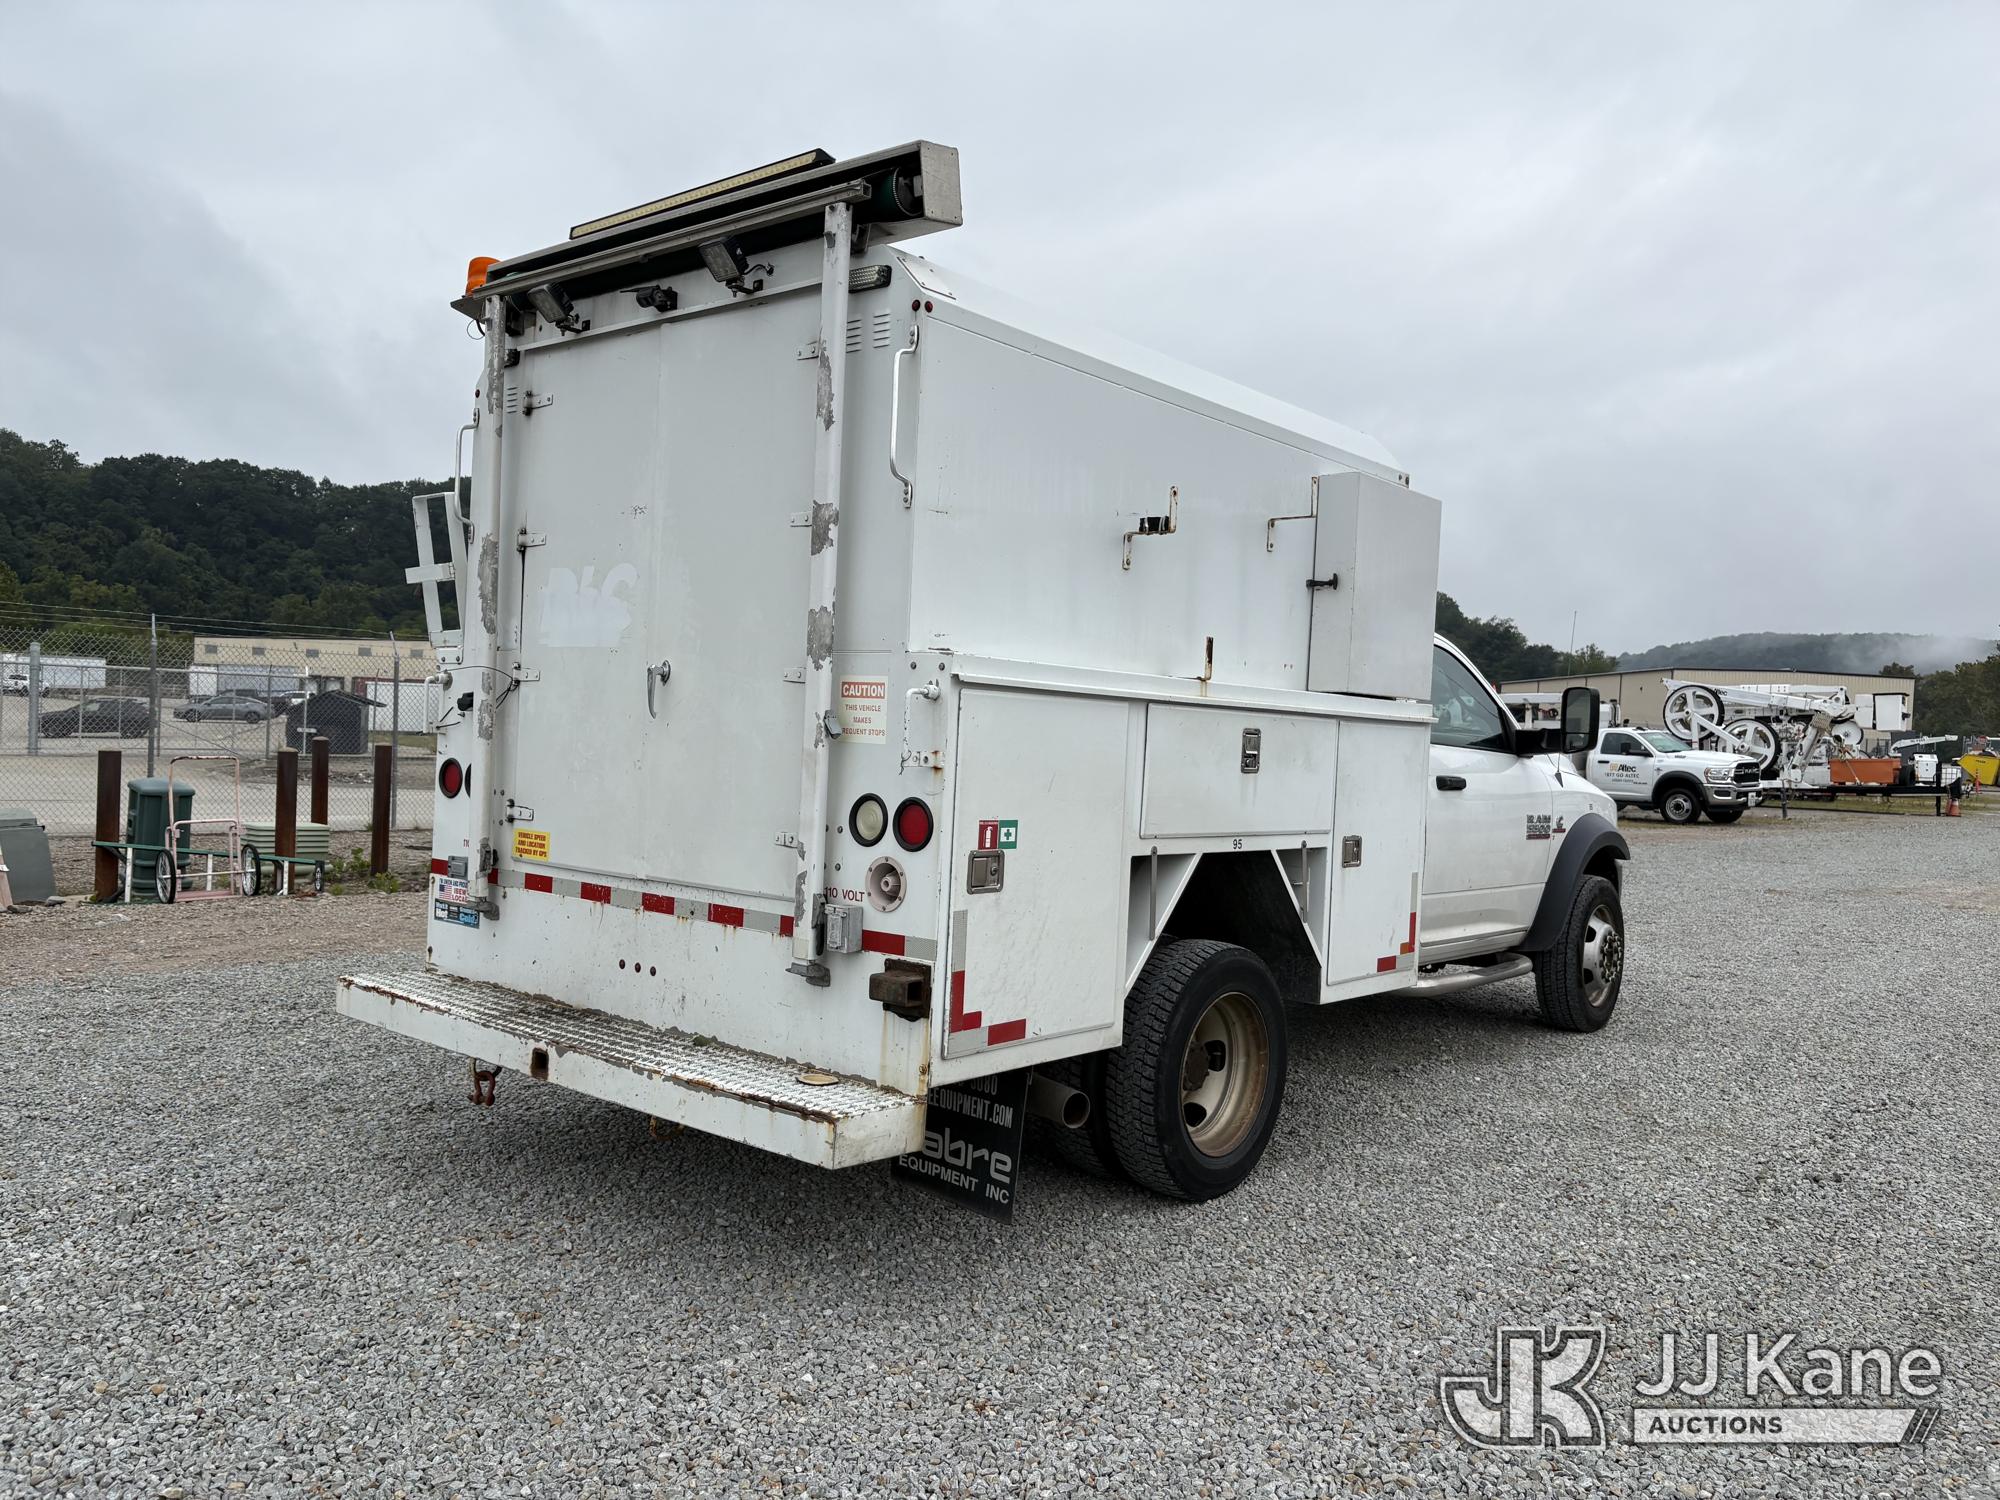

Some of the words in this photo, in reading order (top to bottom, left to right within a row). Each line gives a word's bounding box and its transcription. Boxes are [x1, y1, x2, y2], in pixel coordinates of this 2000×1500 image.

[842, 683, 885, 697] CAUTION
[845, 704, 858, 712] THIS
[858, 704, 882, 713] VEHICLE
[852, 716, 872, 724] MAKES
[841, 727, 867, 736] REQUENT
[868, 728, 886, 737] STOPS
[1617, 763, 1637, 773] Altec
[1526, 814, 1551, 824] RAM
[1232, 838, 1243, 850] 95
[538, 850, 547, 858] GPS
[825, 887, 838, 898] 110
[841, 889, 865, 902] VOLT
[922, 1127, 1012, 1184] abre
[899, 1154, 979, 1192] EQUIPMENT
[985, 1183, 1010, 1204] INC
